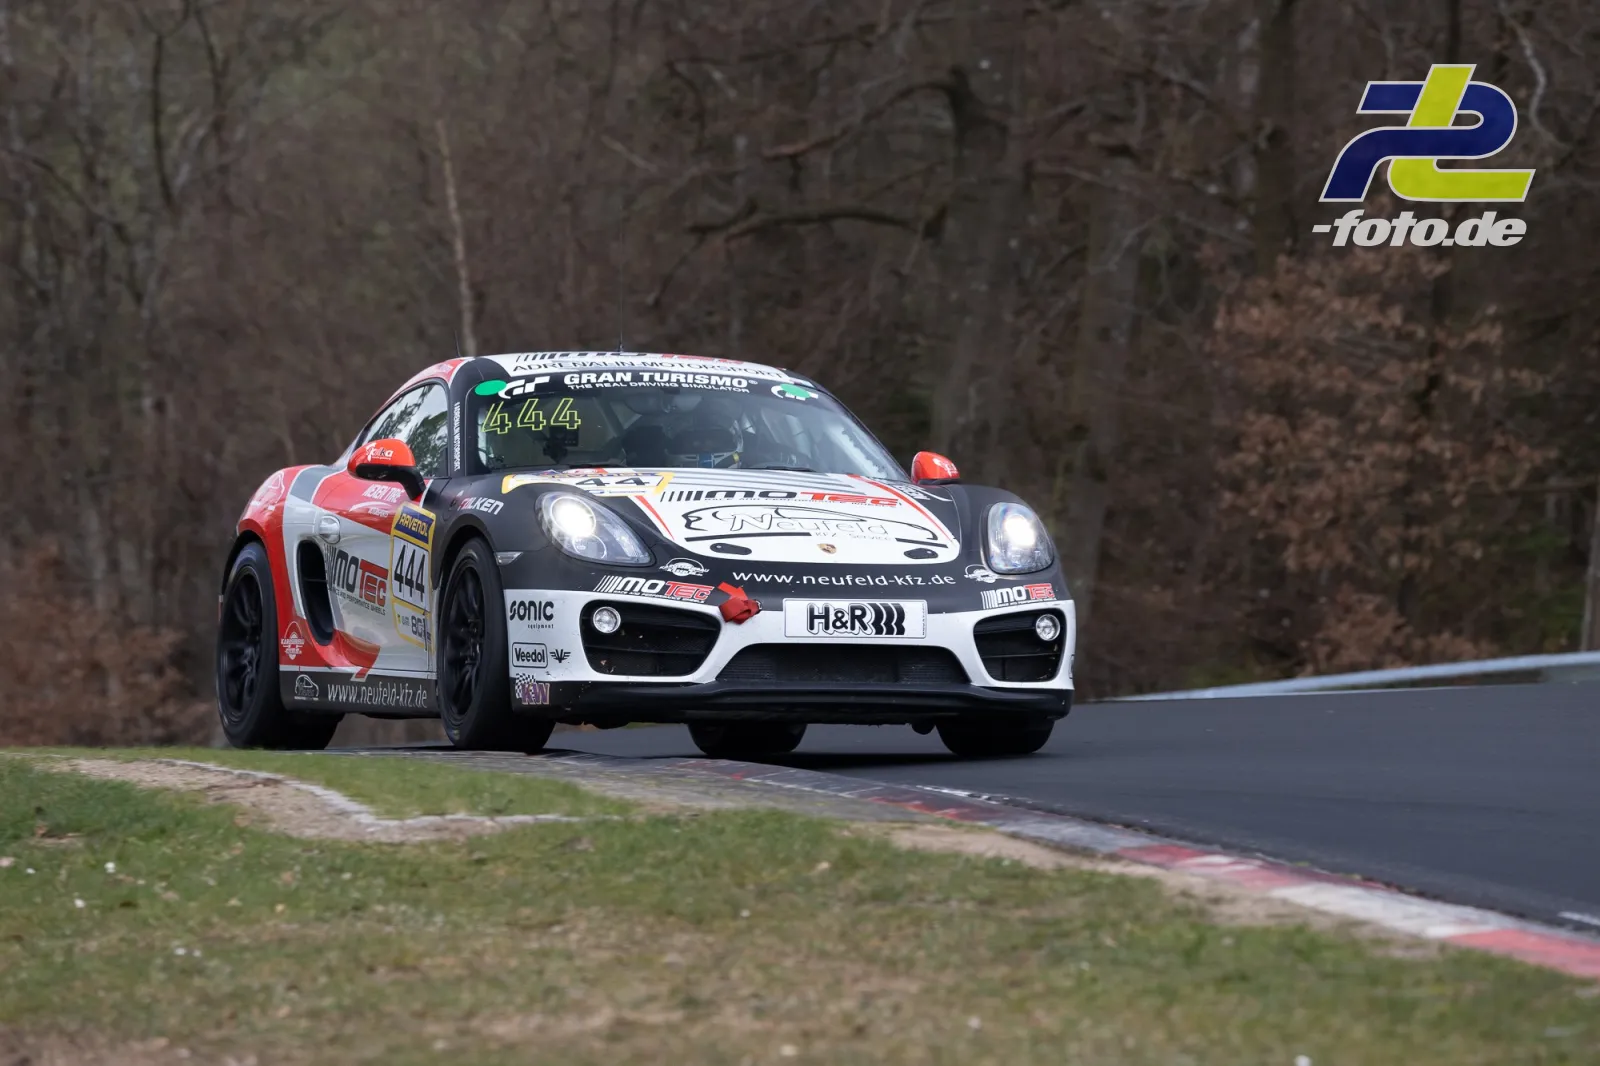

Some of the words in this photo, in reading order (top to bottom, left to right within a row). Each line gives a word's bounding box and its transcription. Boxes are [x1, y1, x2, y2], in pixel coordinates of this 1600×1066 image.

[563, 372, 632, 386] GRAN
[681, 383, 750, 394] SIMULATOR
[481, 398, 581, 434] 444
[399, 512, 429, 537] RAVENOL
[730, 513, 889, 535] Neufeld
[394, 544, 425, 603] 444
[732, 570, 957, 587] www.neufeld-kfz.de
[807, 602, 871, 634] H&R
[514, 647, 546, 663] Veedol
[327, 681, 428, 709] www.neufeld-kfz.de
